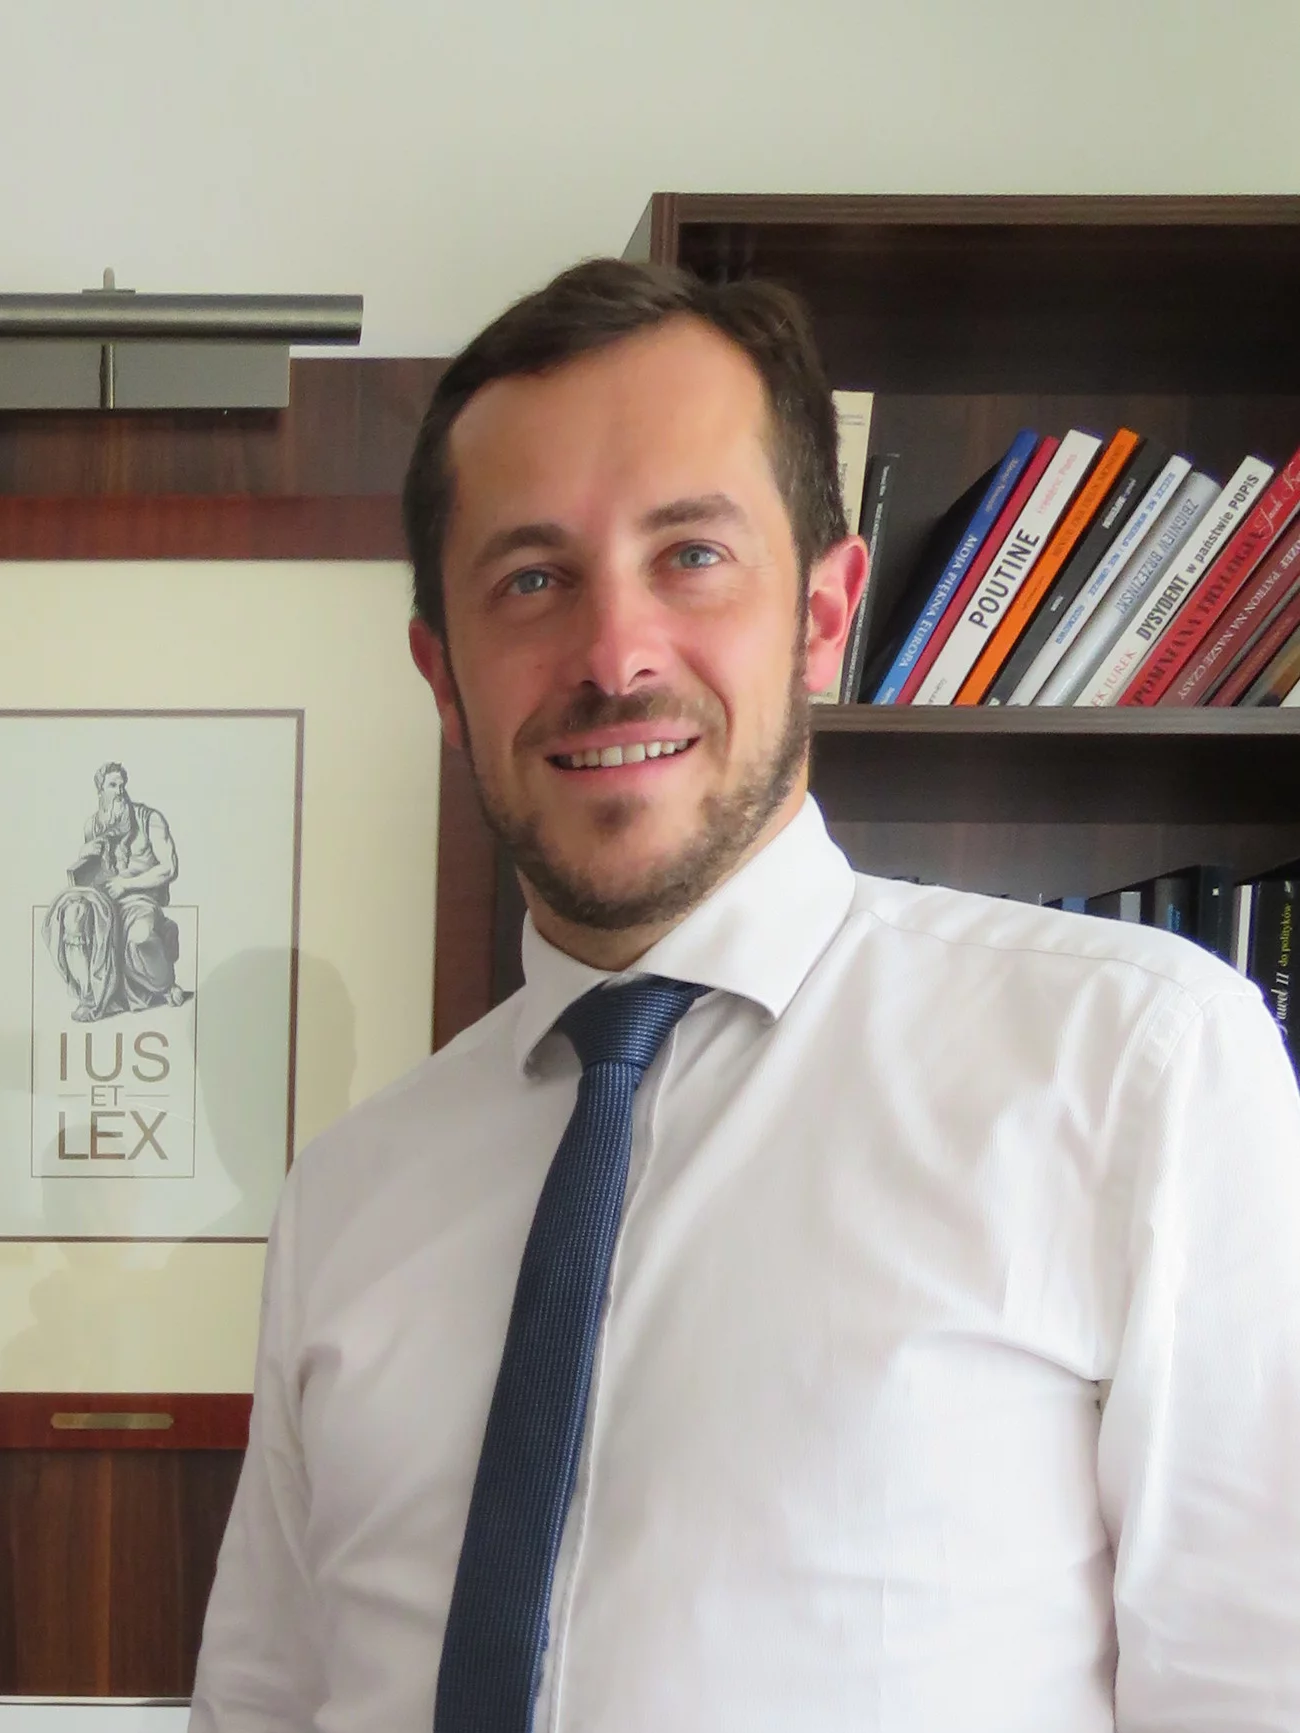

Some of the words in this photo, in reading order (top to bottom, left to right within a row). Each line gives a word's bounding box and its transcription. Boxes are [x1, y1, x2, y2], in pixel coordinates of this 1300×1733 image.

[1228, 472, 1260, 512] POPiS
[954, 533, 979, 564] MOJA
[1155, 497, 1200, 552] ZBIGNIEW
[1191, 509, 1235, 564] państwie
[926, 563, 957, 618] PIĘKNA
[967, 527, 1040, 631] POUTINE
[1113, 549, 1164, 615] BRZEZIŃSKI
[1185, 563, 1199, 576] w
[1242, 568, 1281, 614] PATRON
[1134, 573, 1191, 642] DYSYDENT
[1229, 611, 1248, 632] NA
[898, 617, 932, 669] EUROPA
[1128, 614, 1203, 706] POMNIANA
[1203, 630, 1234, 665] NASZE
[1103, 647, 1138, 691] JUREK
[1175, 663, 1208, 701] CZASY
[1279, 903, 1293, 953] polityków
[1278, 954, 1289, 967] do
[59, 1031, 172, 1083] IUS
[90, 1084, 126, 1108] ET
[57, 1110, 170, 1161] LEX
